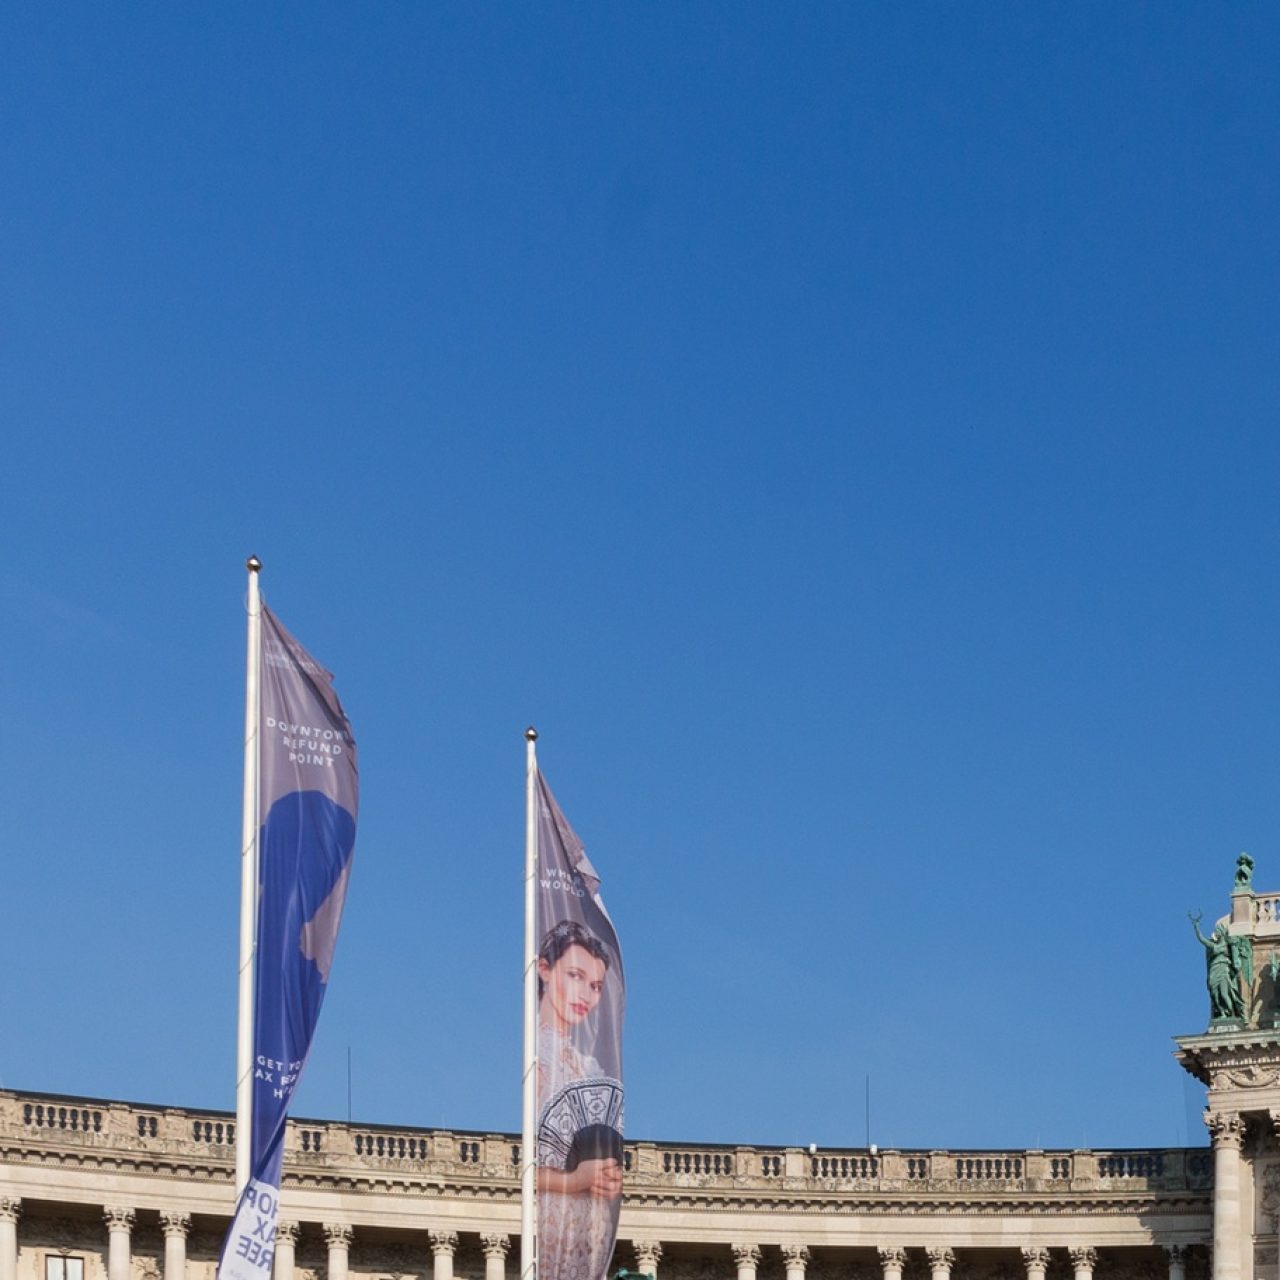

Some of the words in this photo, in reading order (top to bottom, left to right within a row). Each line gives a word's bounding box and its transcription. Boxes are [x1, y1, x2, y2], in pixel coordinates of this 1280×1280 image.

[288, 752, 334, 767] POINT
[540, 879, 585, 898] WOULD
[257, 1055, 283, 1071] GET
